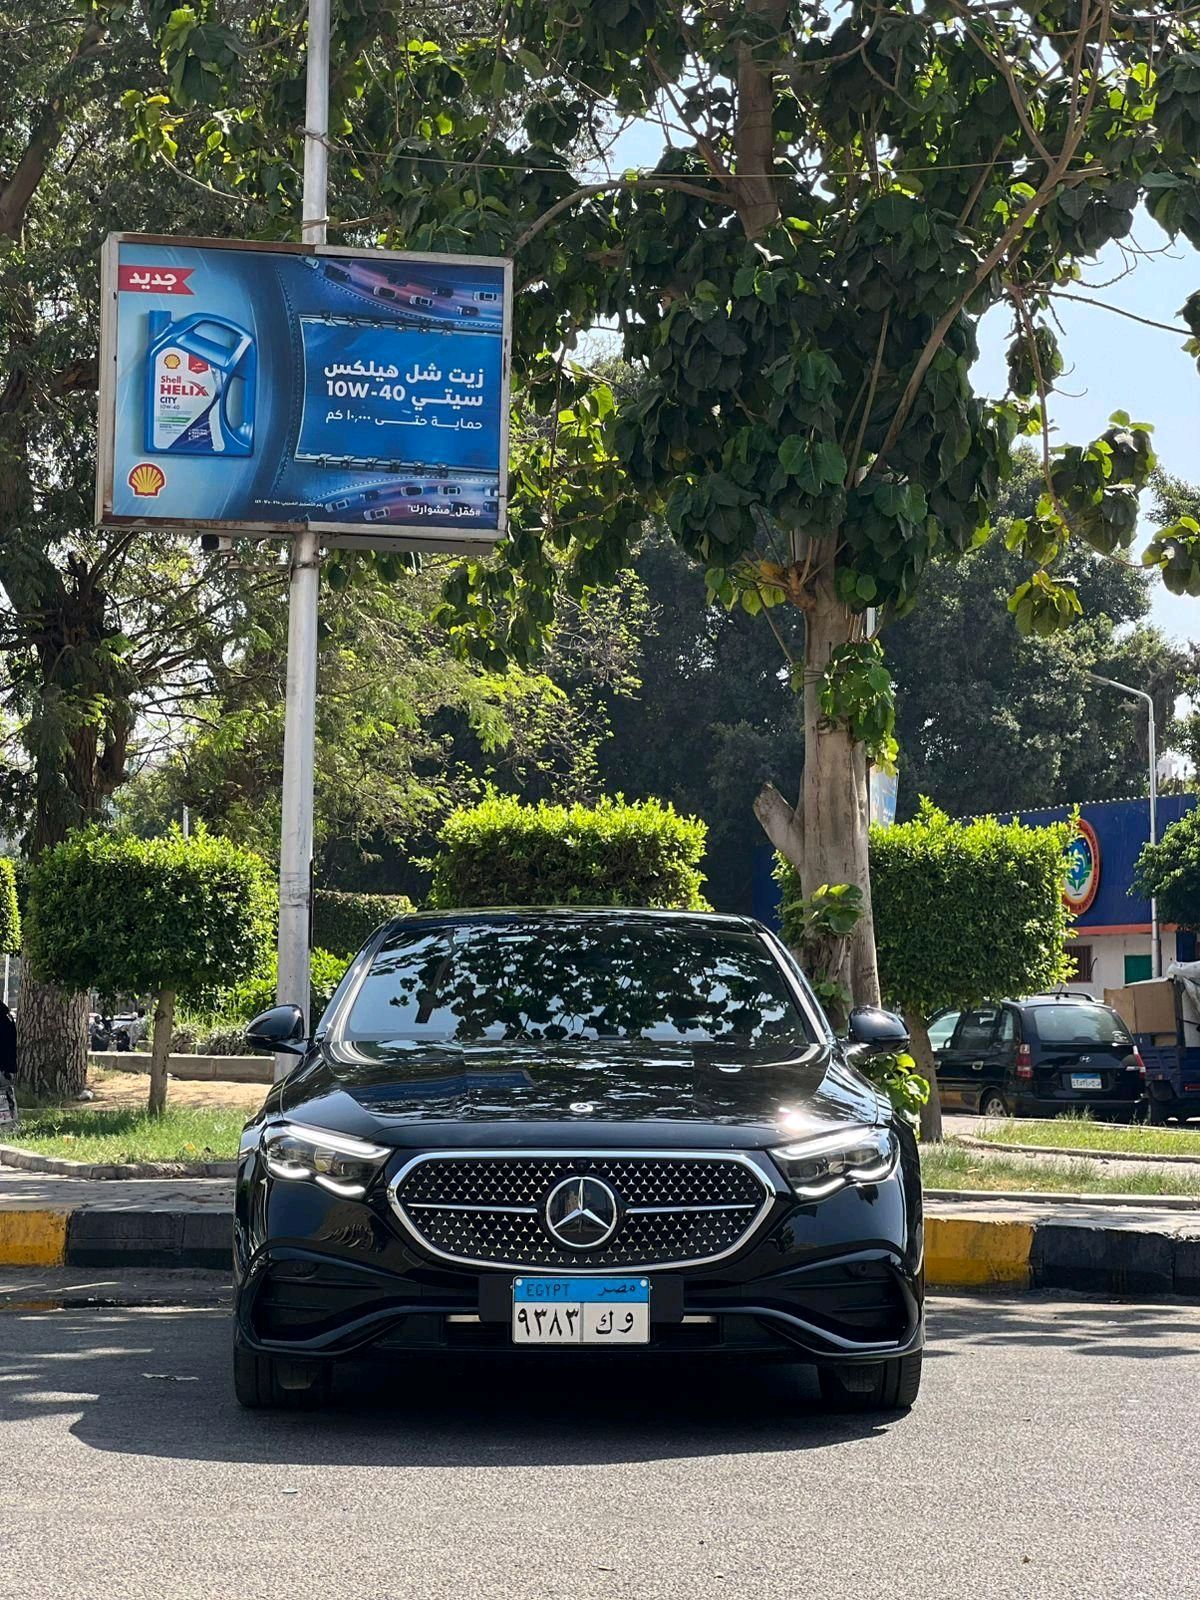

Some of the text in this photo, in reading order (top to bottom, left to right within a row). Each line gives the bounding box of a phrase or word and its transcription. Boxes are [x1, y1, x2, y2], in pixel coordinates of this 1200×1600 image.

[129, 272, 177, 291] جديد
[160, 375, 181, 384] Shell
[324, 360, 484, 389] زيت شل هيلكس
[160, 383, 209, 397] HELIX
[326, 380, 483, 411] سيتي 10W-40
[325, 409, 343, 424] كم
[374, 414, 428, 426] حتى
[431, 415, 483, 431] حماية
[526, 1283, 570, 1297] EGYPT
[597, 1283, 636, 1297] مصر
[517, 1307, 580, 1337] ٩٣٨٣
